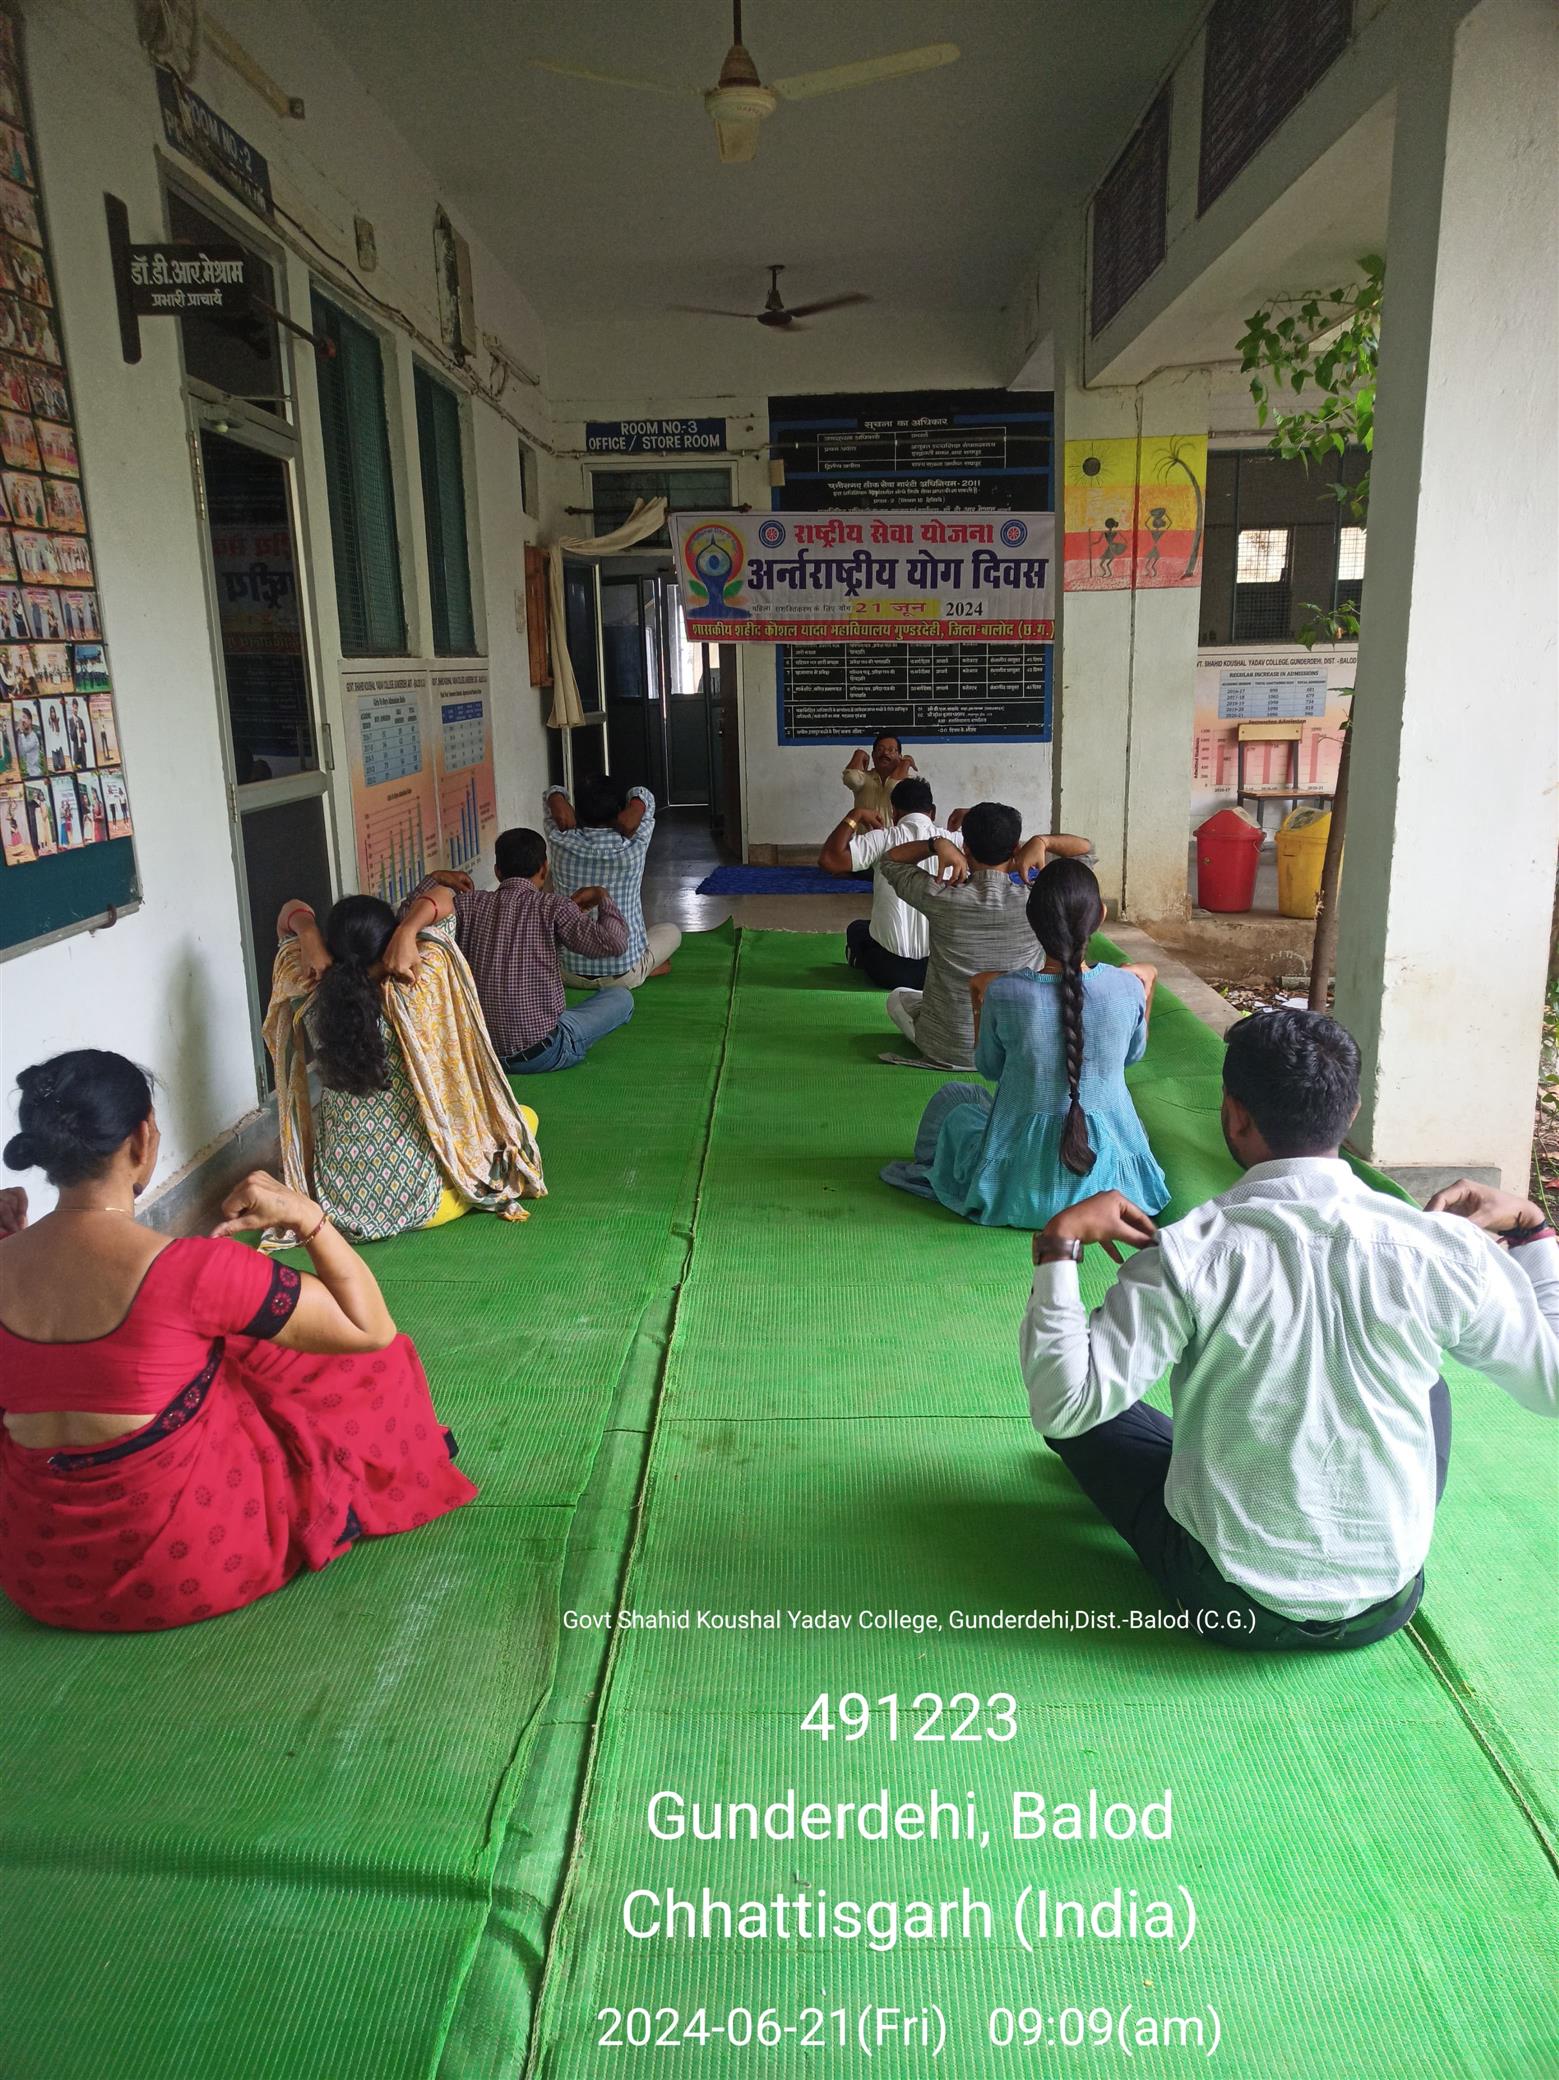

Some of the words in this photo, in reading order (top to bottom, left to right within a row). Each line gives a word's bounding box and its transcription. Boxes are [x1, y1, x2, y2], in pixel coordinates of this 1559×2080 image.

[151, 289, 186, 308] प्रभारी
[187, 288, 223, 306] प्राचार्य
[621, 422, 659, 435] ROOM
[588, 436, 626, 450] OFFICE
[642, 434, 681, 449] STORE
[684, 434, 720, 448] ROOM
[962, 479, 981, 487] 2011
[794, 519, 863, 548] राष्ट्रीय
[870, 519, 914, 544] सेवा
[920, 519, 994, 544] योजना
[906, 549, 962, 590] योग
[972, 550, 1050, 590] दिवस
[855, 603, 881, 614] 21
[892, 602, 926, 617] जून
[945, 600, 984, 617] 2024
[692, 622, 733, 637] शासकीय
[734, 621, 761, 636] शहीद
[801, 622, 828, 636] यादव
[831, 621, 891, 636] महाविद्यालय
[1248, 658, 1266, 667] YADAV
